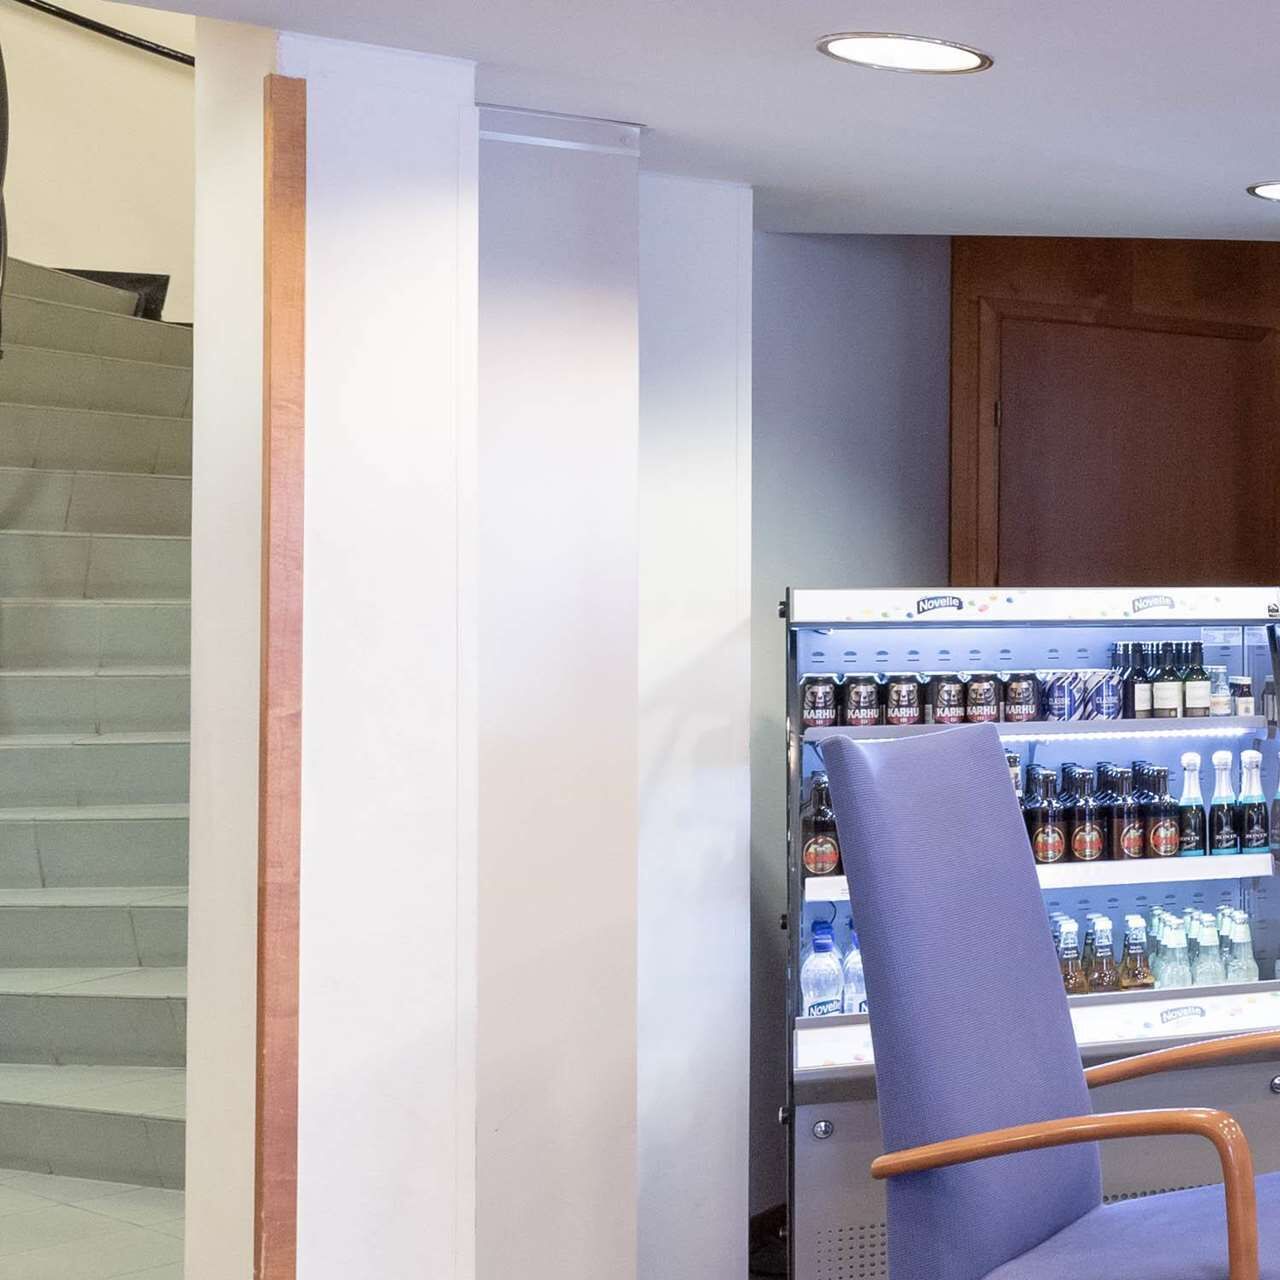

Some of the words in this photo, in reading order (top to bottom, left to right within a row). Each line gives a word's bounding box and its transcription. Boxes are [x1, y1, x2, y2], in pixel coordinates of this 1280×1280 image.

[919, 596, 960, 613] Novelle
[803, 708, 837, 720] KARHU
[847, 708, 880, 719] KARHU
[887, 707, 920, 718] KARHU
[966, 704, 998, 716] KARHU
